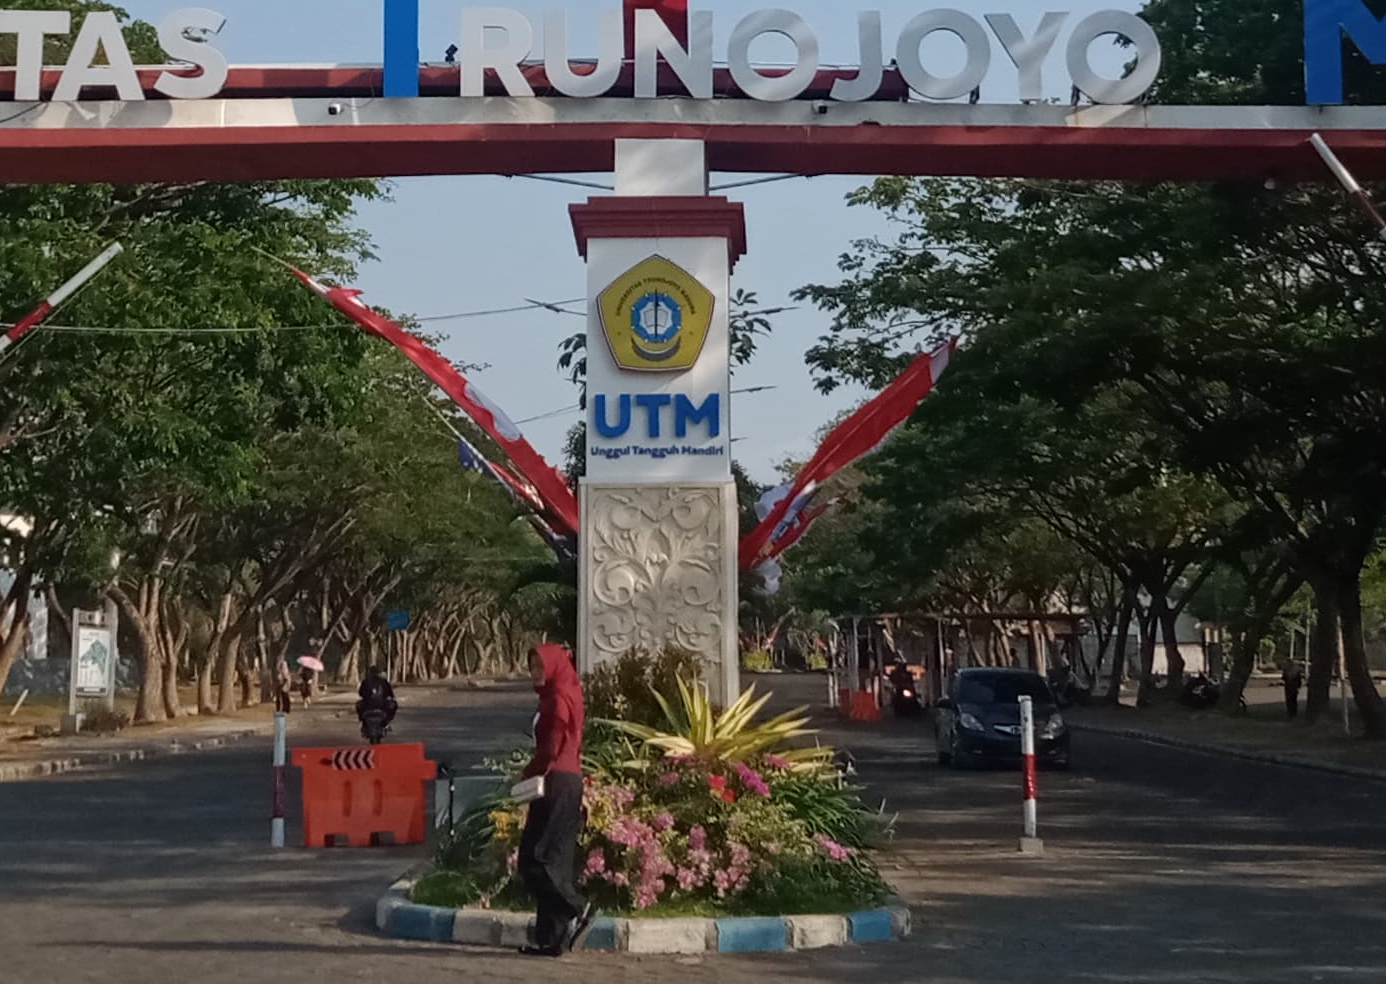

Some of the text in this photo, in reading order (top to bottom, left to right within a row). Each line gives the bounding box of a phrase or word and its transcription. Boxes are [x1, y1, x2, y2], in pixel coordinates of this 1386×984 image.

[594, 393, 720, 439] UTM
[591, 445, 724, 459] Unggul Tangguh Mandiri
